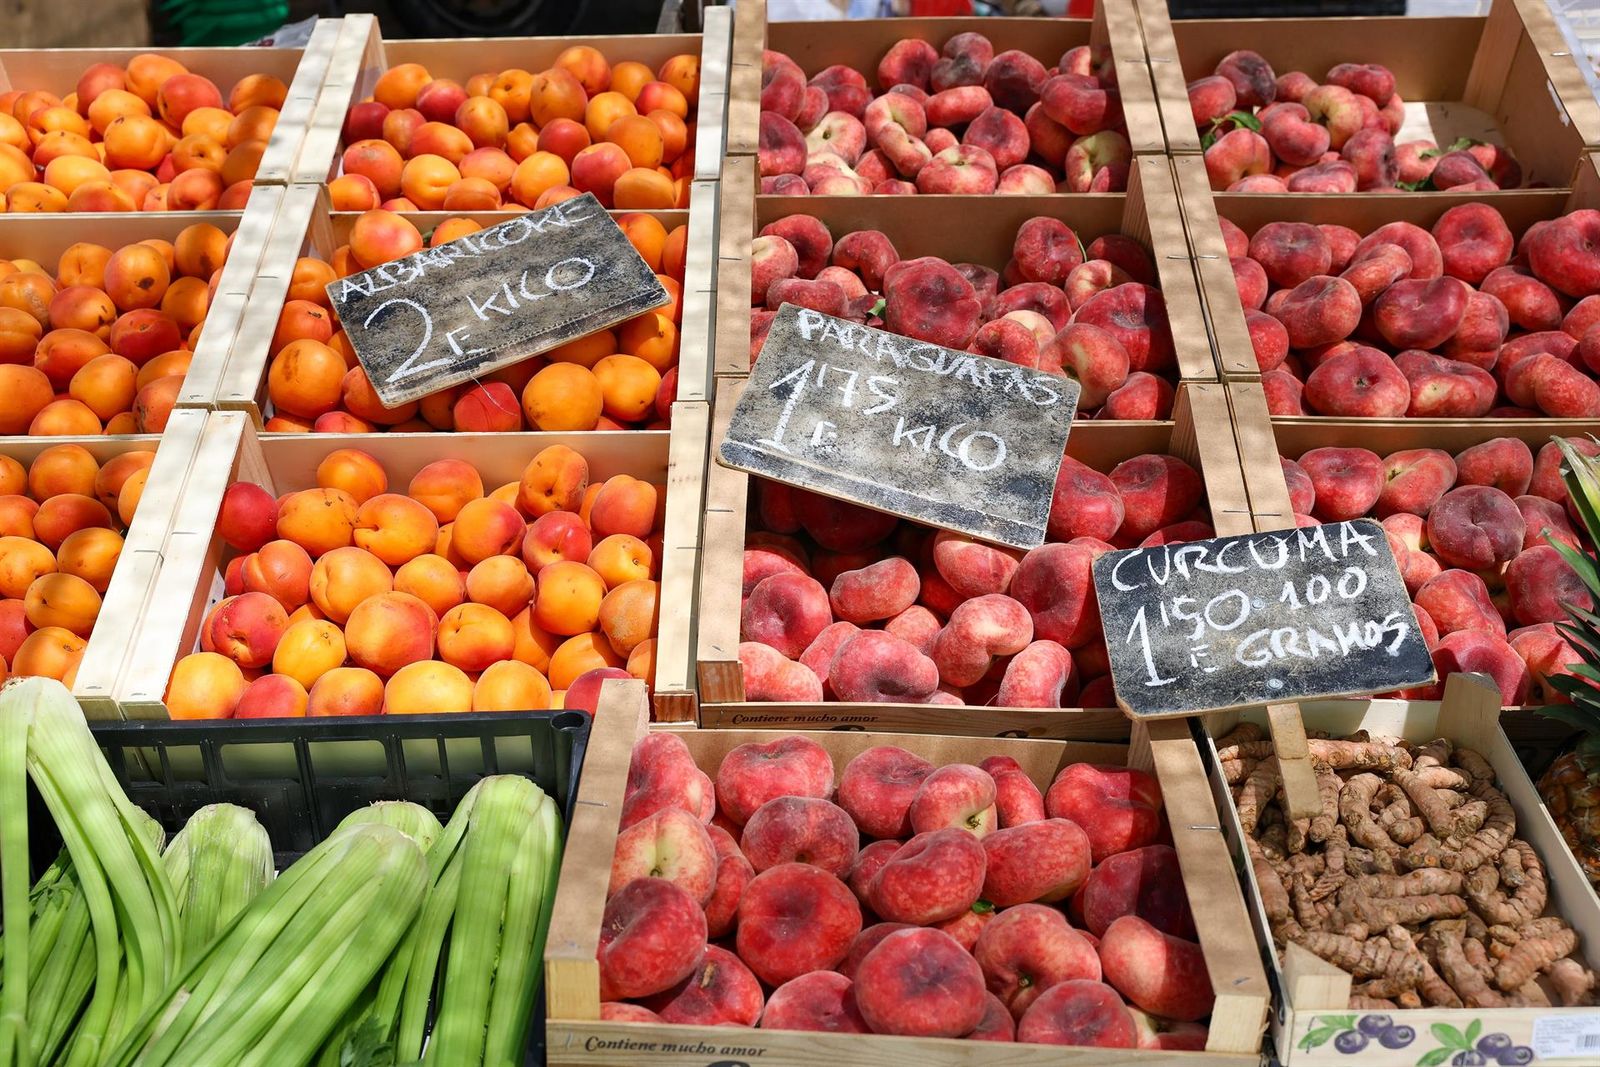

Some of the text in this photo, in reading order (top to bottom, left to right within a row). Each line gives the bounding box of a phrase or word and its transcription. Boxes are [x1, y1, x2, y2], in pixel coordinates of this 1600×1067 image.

[364, 299, 456, 383] 2
[1111, 521, 1379, 591] CURCUMA
[1279, 566, 1368, 611] 100
[1235, 611, 1410, 668] GRAMOS
[732, 713, 879, 725] Contiene mucho amor
[584, 1035, 768, 1057] Contiene mucho amor
